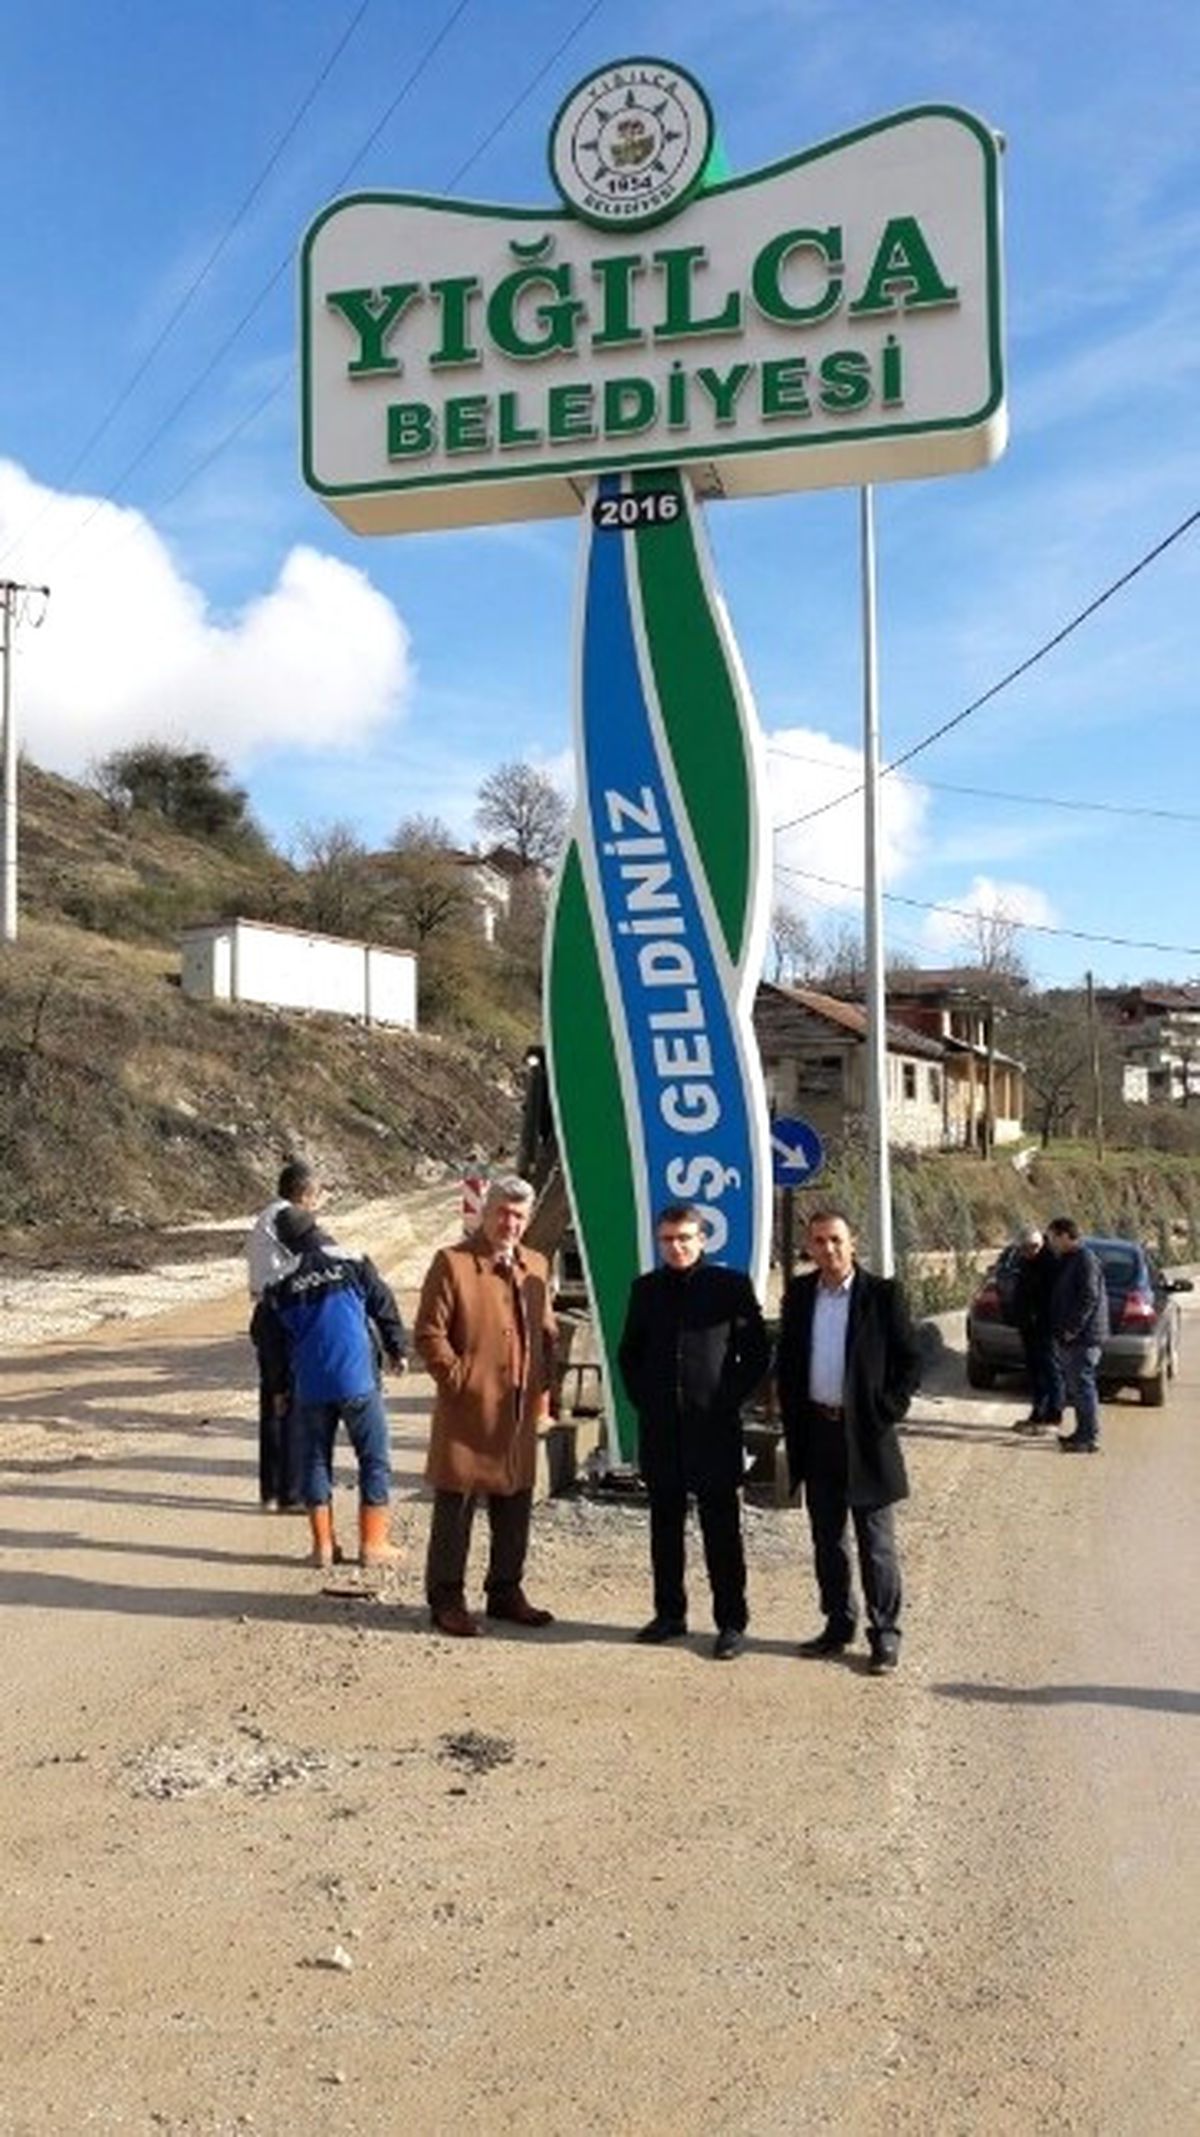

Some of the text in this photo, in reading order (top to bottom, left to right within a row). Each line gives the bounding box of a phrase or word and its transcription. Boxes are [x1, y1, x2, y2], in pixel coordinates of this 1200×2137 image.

[327, 215, 957, 379] YIĞILCA
[387, 334, 905, 462] BELEDİYESİ
[600, 494, 679, 525] 2016
[604, 786, 741, 1266] OŞ GELDİNİZ
